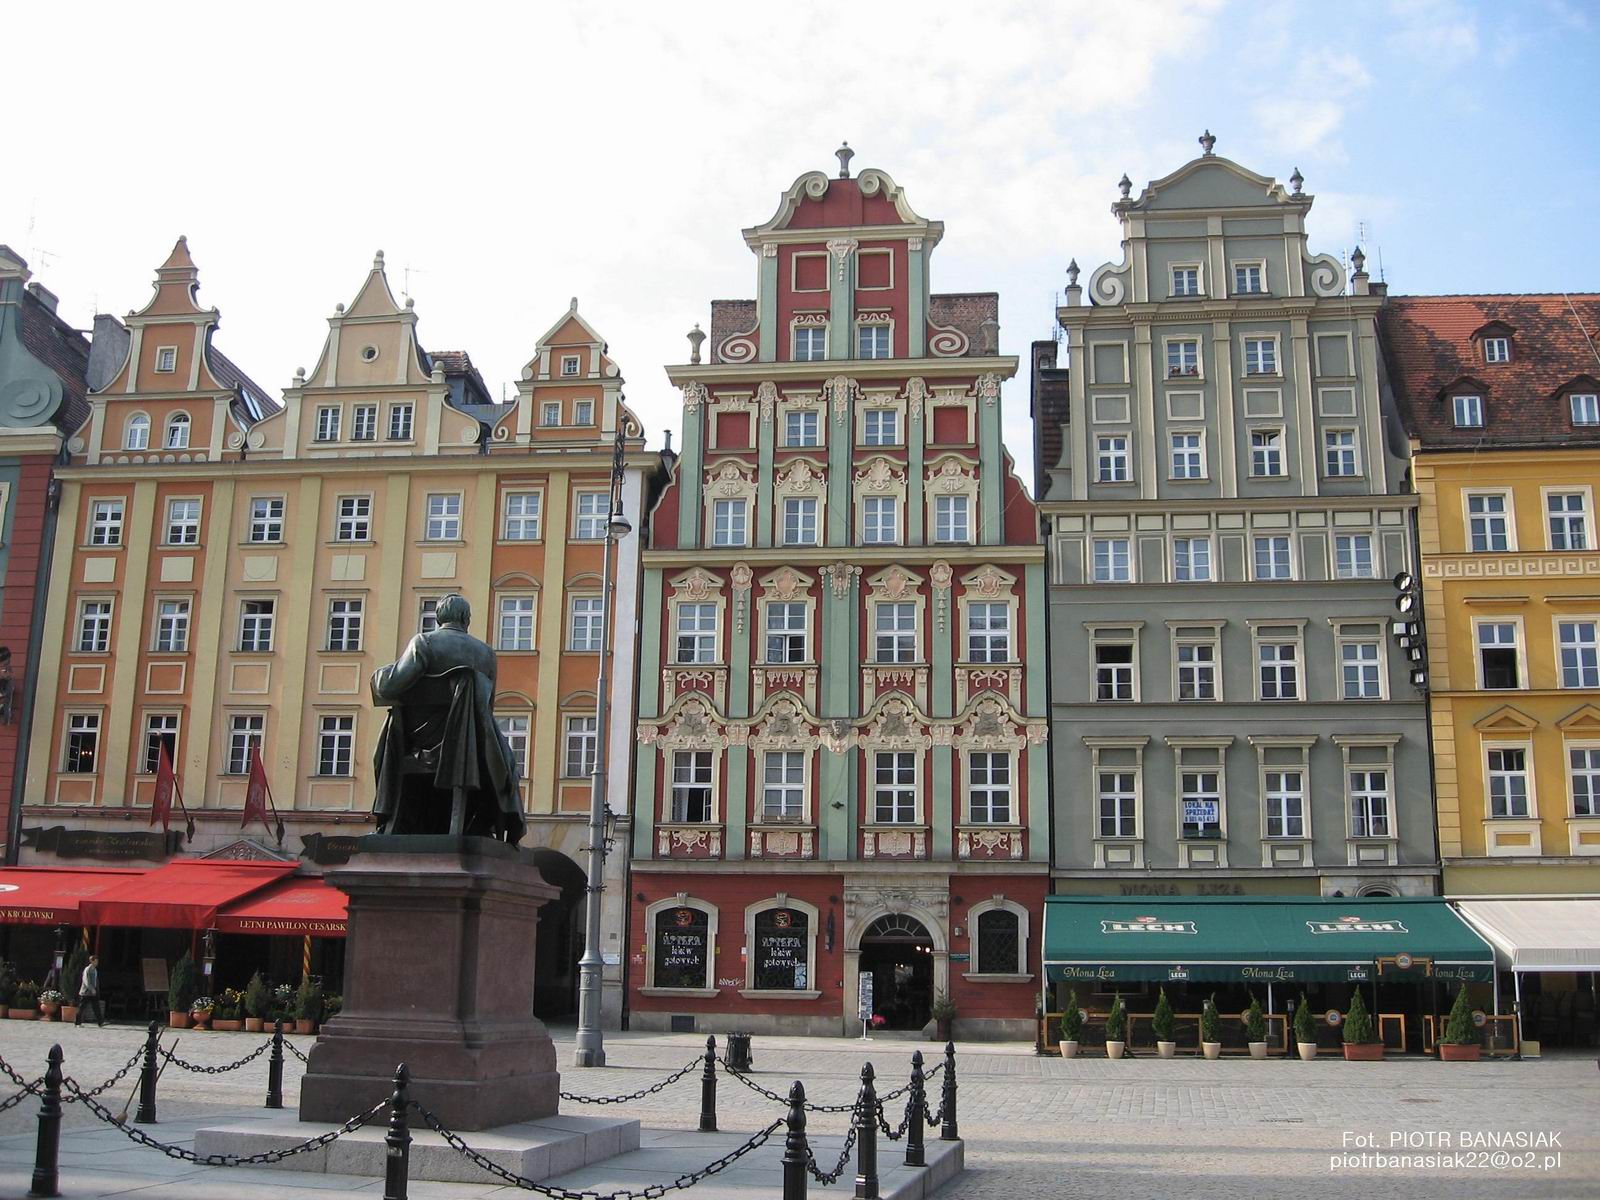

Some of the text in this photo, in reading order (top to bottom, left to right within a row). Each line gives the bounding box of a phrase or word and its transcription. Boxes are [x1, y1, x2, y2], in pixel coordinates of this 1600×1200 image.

[239, 920, 346, 931] LETNI PAWILON CESARSK
[1112, 923, 1185, 931] LECH
[1319, 923, 1395, 931] LECH
[1063, 965, 1115, 980] Mona Liza
[1241, 966, 1295, 980] Mona Liza
[1350, 971, 1366, 979] LECH
[1455, 967, 1475, 980] Liza
